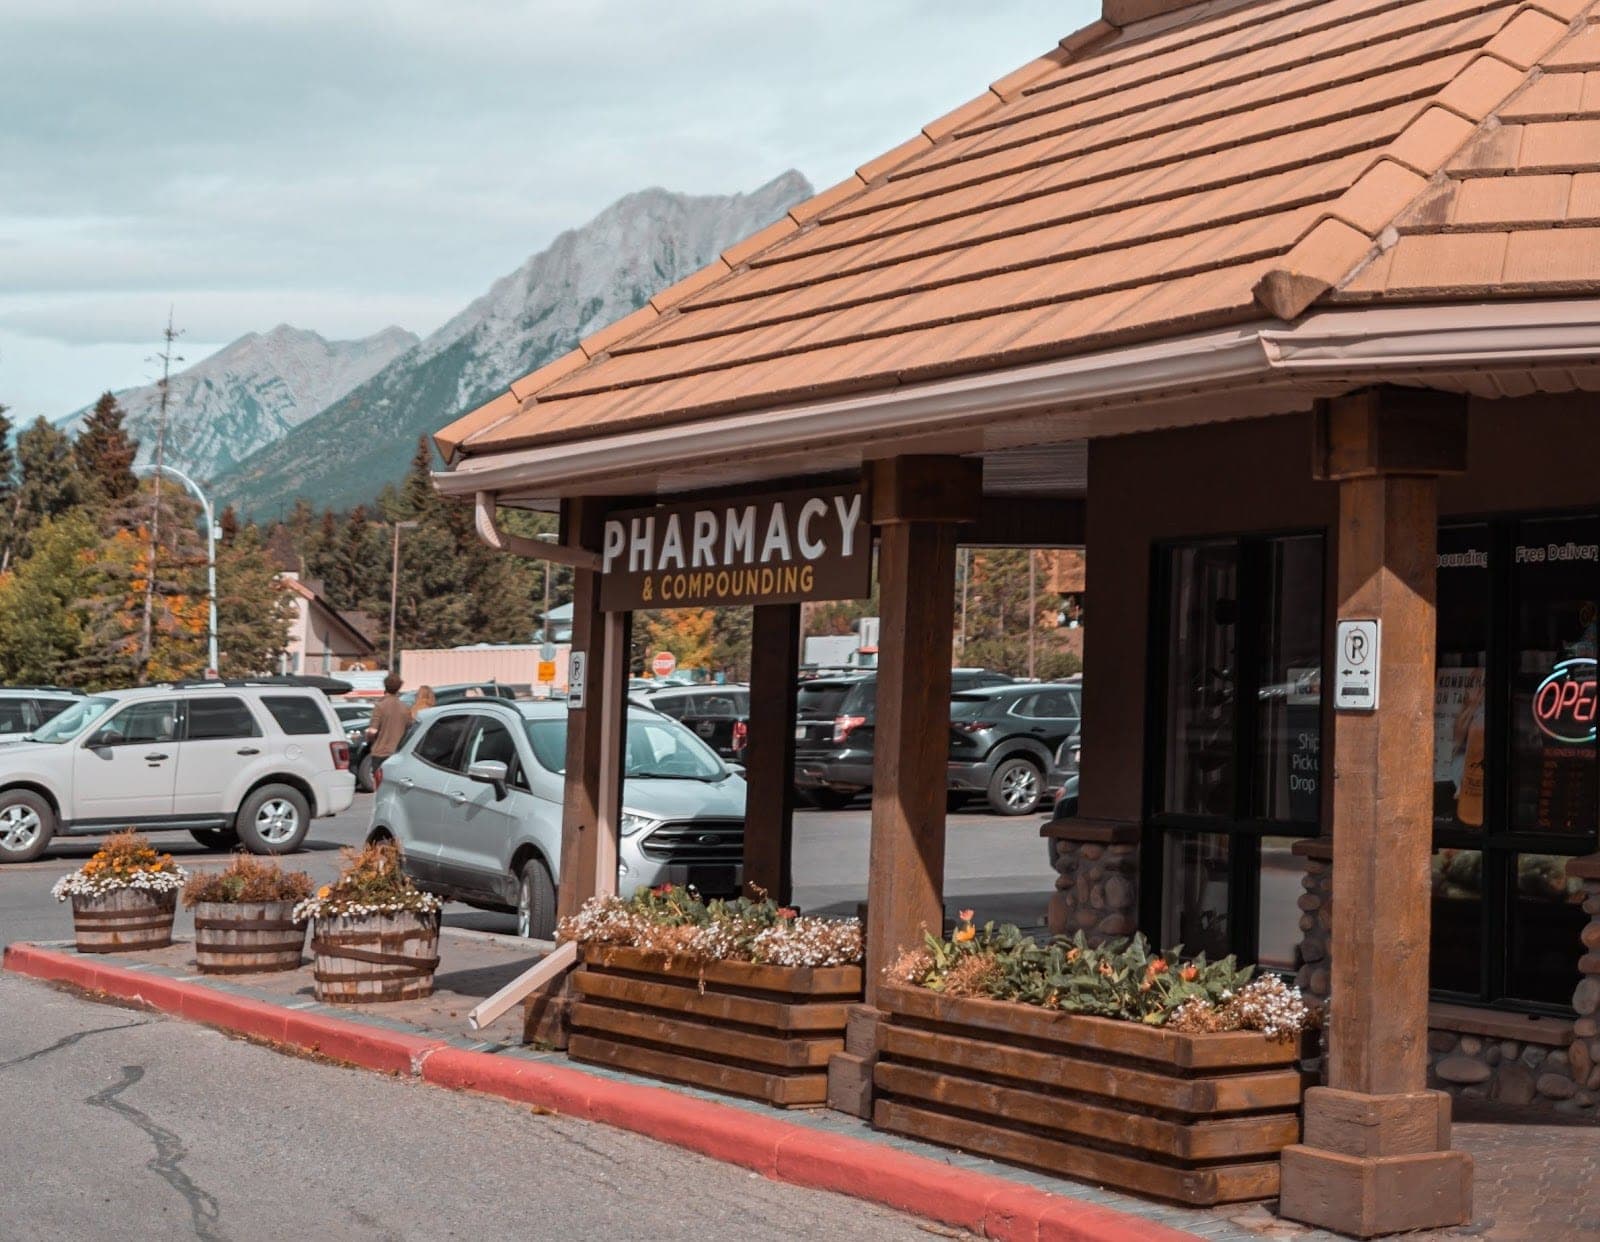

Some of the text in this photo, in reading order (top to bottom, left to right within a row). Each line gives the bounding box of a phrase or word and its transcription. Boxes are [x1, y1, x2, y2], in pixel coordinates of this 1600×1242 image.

[603, 494, 862, 574] PHARMACY
[1515, 546, 1546, 563] Free
[642, 565, 814, 601] & COMPOUNDING
[1290, 774, 1316, 794] Drop
